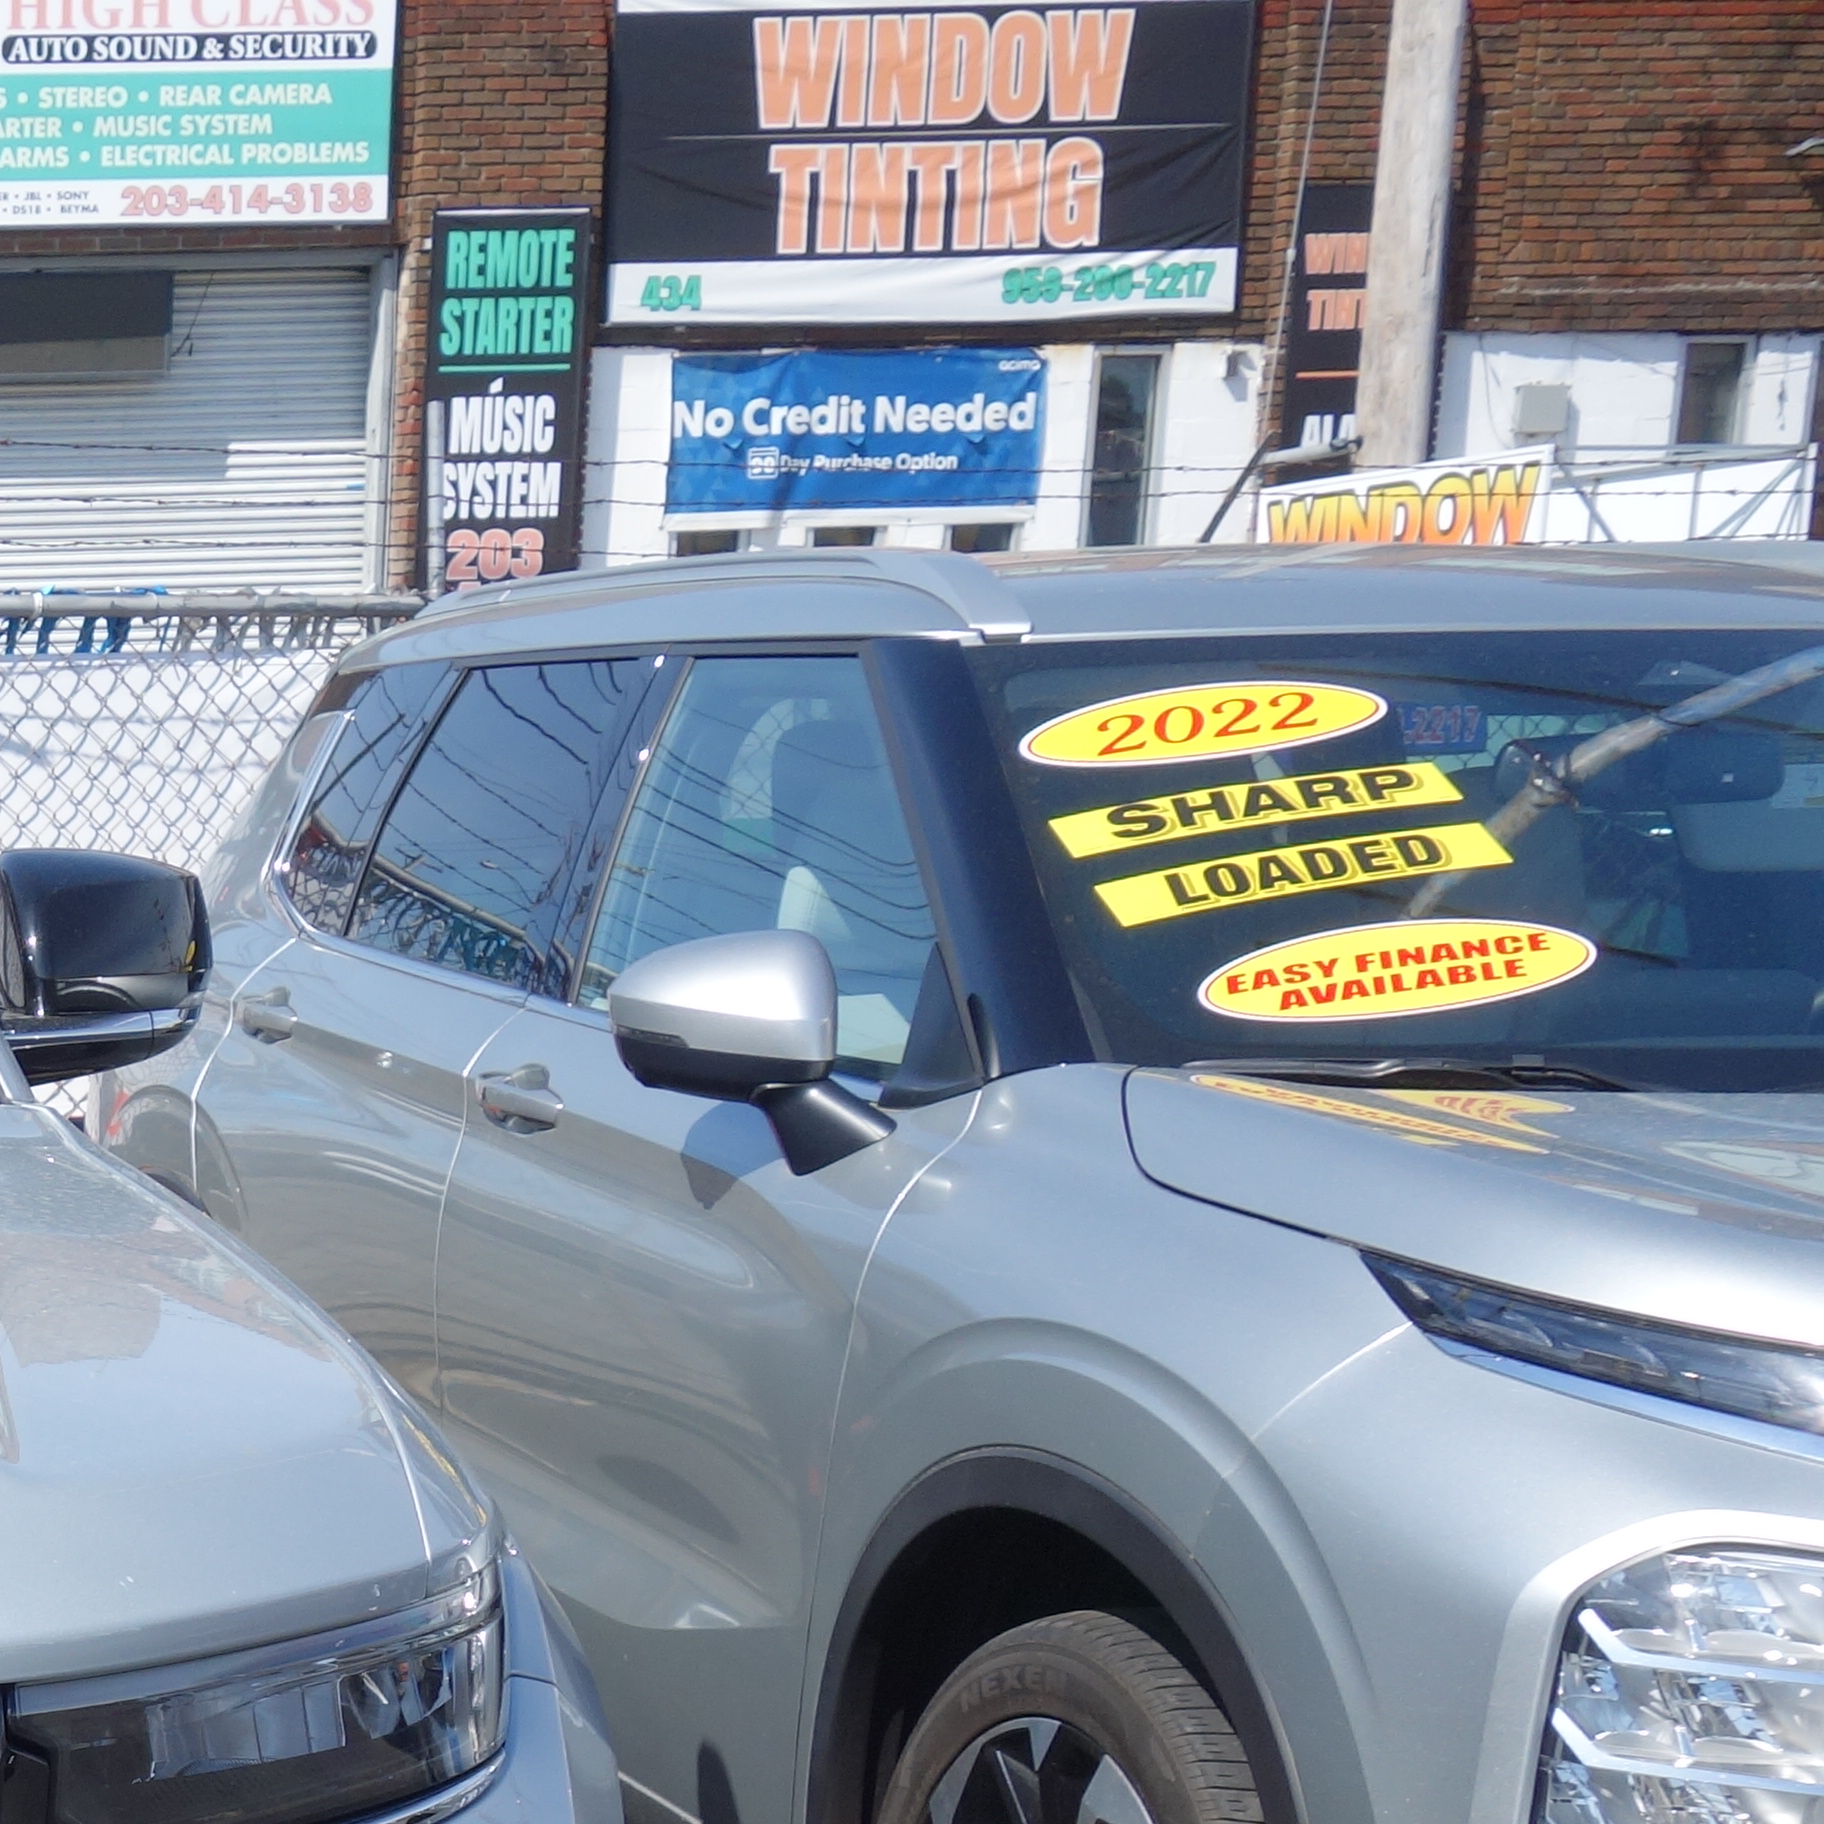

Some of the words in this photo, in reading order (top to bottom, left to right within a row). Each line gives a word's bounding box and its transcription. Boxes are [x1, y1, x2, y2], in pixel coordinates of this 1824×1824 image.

[8, 36, 88, 62] AUTO
[93, 35, 197, 61] SOUND
[203, 37, 223, 60] &
[229, 32, 371, 59] SECURITY
[753, 8, 1136, 129] WINDOW
[38, 85, 128, 108] STEREO
[160, 85, 222, 106] REAR
[229, 83, 333, 105] CAMERA
[93, 115, 172, 137] MUSIC
[180, 114, 272, 135] SYSTEM
[101, 144, 234, 167] ELECTRICAL
[241, 142, 370, 164] PROBLEMS
[24, 190, 42, 202] JBL
[57, 190, 90, 201] SONY
[60, 203, 100, 214] BEYMA
[120, 182, 373, 217] 203-414-3138
[768, 136, 1104, 255] TINTING
[446, 229, 575, 289] REMOTE
[1304, 232, 1369, 275] WIN
[641, 274, 702, 312] 434
[439, 296, 574, 356] STARTER
[672, 399, 734, 438] No
[743, 394, 866, 436] Credit
[874, 391, 1036, 434] Needed
[1301, 414, 1356, 447] ALA
[780, 455, 811, 477] Day
[813, 453, 893, 472] Purchase
[895, 452, 958, 474] Option
[443, 461, 562, 520] SYSTEM
[1268, 460, 1542, 544] WINDOW
[446, 527, 544, 580] 203
[1096, 691, 1319, 757] 2022
[1396, 704, 1482, 745] 2217
[1106, 769, 1422, 841] SHARP
[1165, 834, 1450, 909] LOADED
[1225, 957, 1339, 995] EASY
[1355, 932, 1551, 974] FINANCE
[1279, 957, 1527, 1012] AVAILABLE
